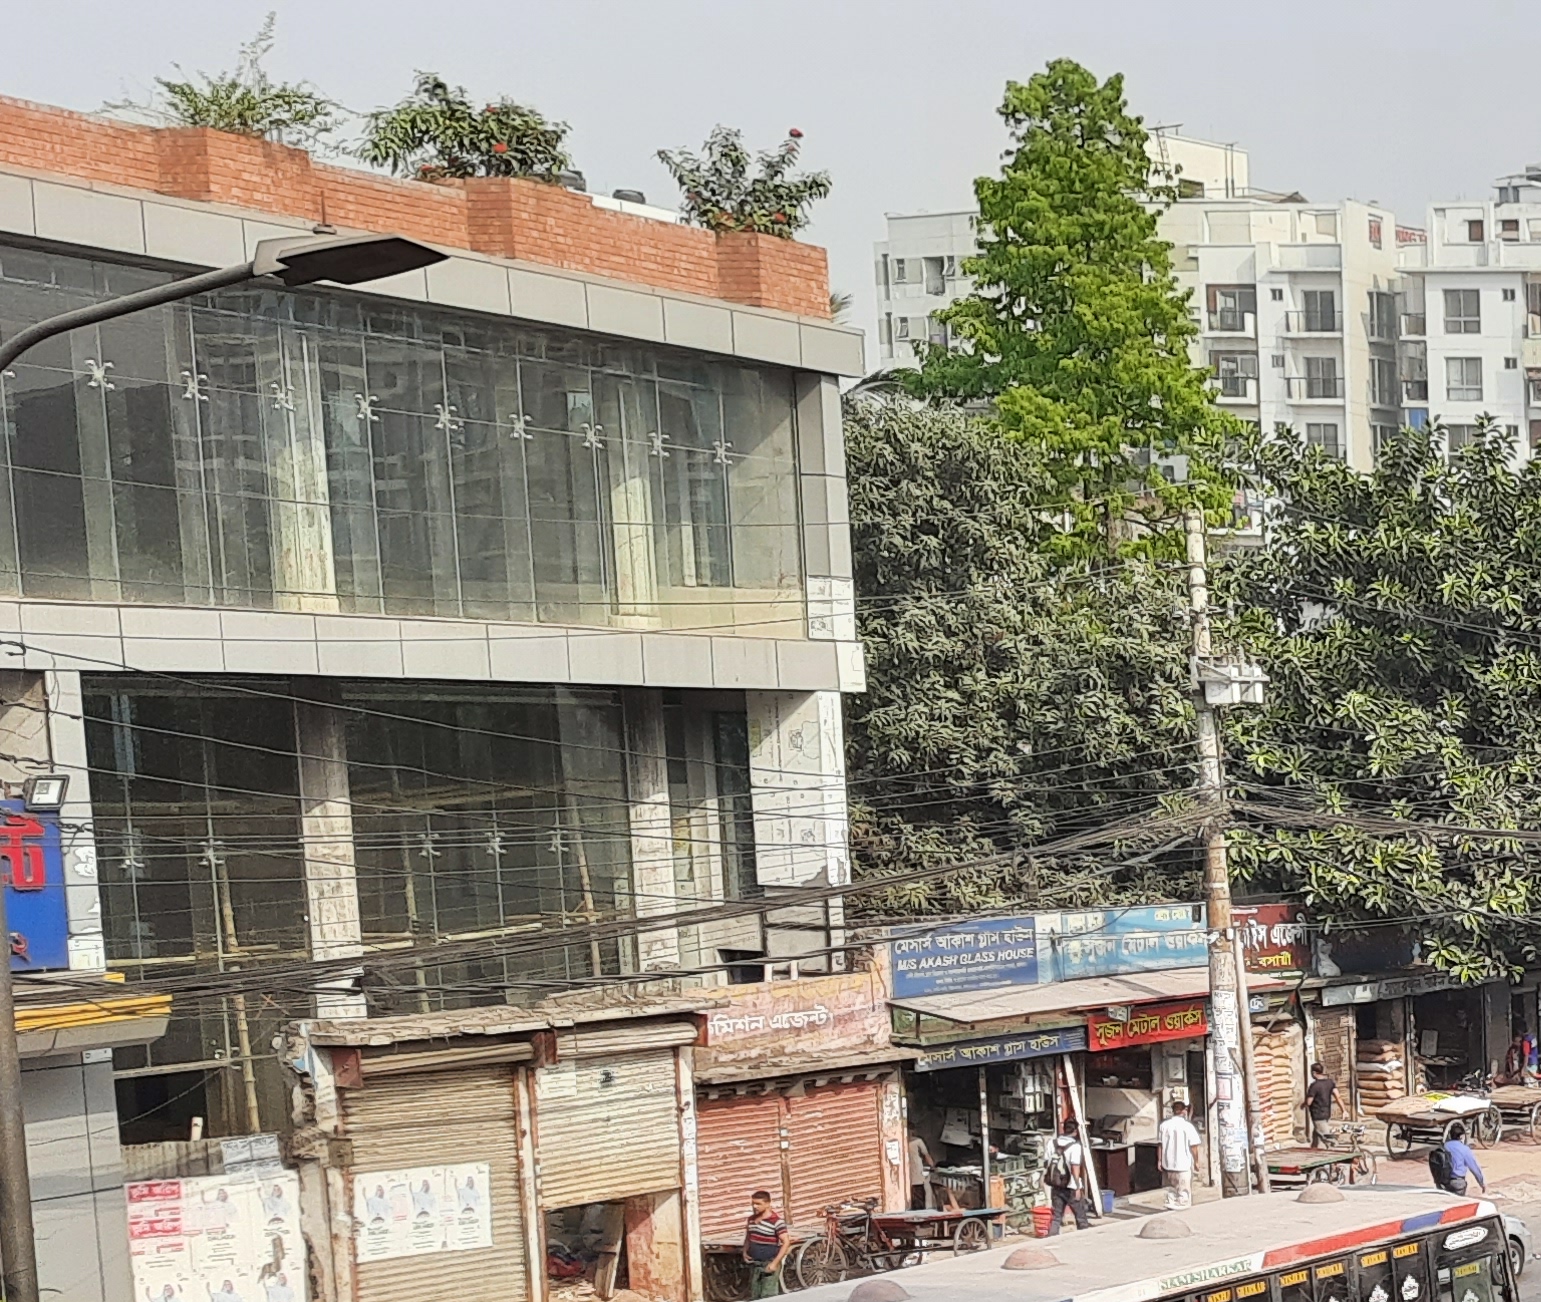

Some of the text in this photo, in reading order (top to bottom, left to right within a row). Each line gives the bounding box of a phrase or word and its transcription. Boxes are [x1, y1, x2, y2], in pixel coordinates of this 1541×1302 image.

[919, 954, 958, 970] AKASH
[960, 951, 995, 965] GLASS
[997, 948, 1034, 961] HOUSE
